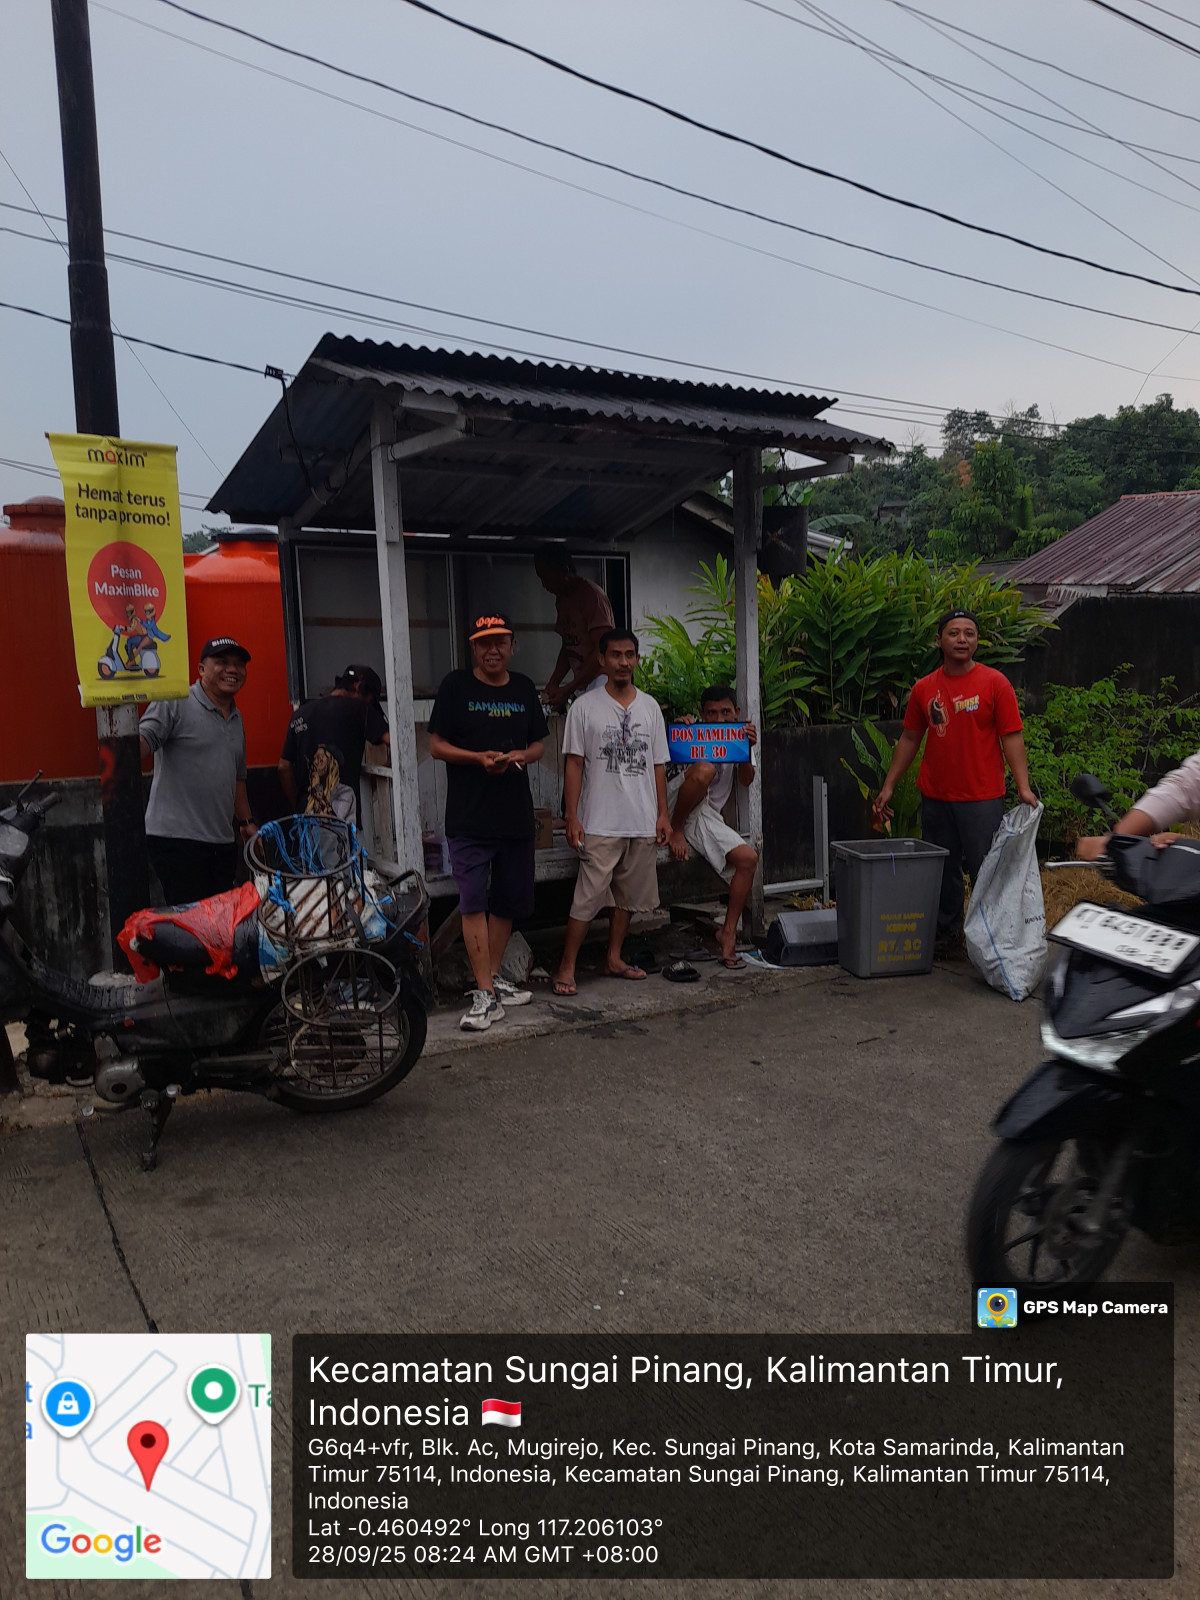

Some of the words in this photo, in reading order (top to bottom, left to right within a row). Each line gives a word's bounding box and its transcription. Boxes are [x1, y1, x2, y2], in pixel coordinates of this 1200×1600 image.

[88, 448, 145, 468] maxim
[78, 482, 123, 504] Hemat
[127, 490, 166, 508] terus
[75, 503, 117, 523] tanpa
[119, 511, 171, 526] promo!
[111, 564, 142, 579] Pesan
[94, 581, 160, 598] MaximBike
[468, 701, 526, 713] SAMARINDA
[671, 728, 694, 742] POS
[696, 727, 745, 742] KAMLING
[690, 745, 708, 759] RT.
[712, 745, 727, 759] 30
